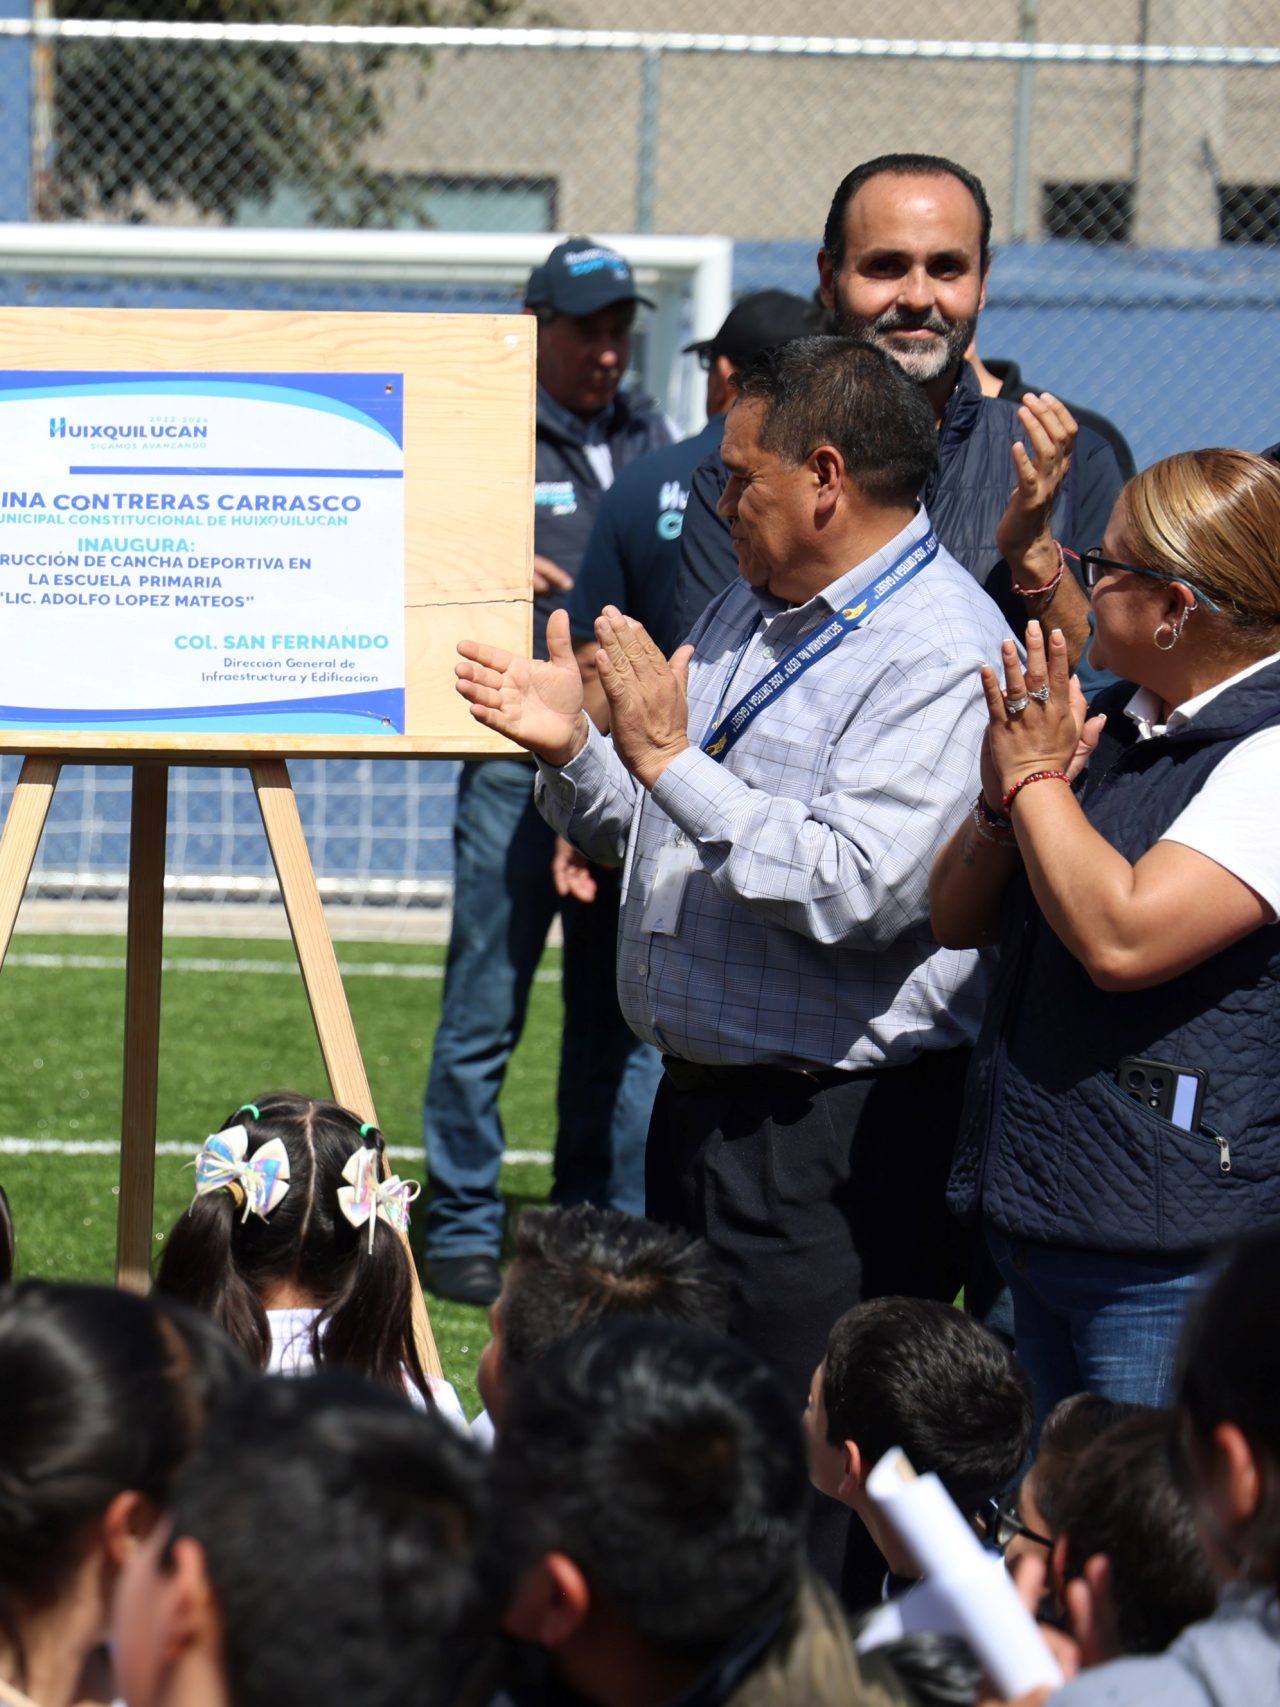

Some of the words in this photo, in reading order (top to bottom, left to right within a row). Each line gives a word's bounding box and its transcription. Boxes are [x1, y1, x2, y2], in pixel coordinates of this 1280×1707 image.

[49, 417, 208, 440] HUIXQUILUCAN
[90, 442, 138, 450] SIGAMOS
[142, 441, 208, 449] AVANZANDO
[53, 493, 211, 511] CONTRERAS
[217, 494, 362, 512] CARRASCO
[68, 514, 204, 526] CONSTITUCIONAL
[207, 515, 227, 526] DE
[231, 515, 349, 527] HUIXQUILUCAN
[78, 537, 196, 553] INAUGURA:
[83, 555, 106, 568] DE
[110, 555, 183, 569] CANCHA
[187, 557, 285, 570] DEPORTIVA
[288, 557, 312, 570] EN
[28, 573, 50, 586] LA
[53, 574, 132, 587] ESCUELA
[139, 575, 222, 588] PRIMARIA
[40, 593, 111, 606] ADOLFO
[115, 594, 171, 607] LOPEZ
[174, 634, 218, 650] COL.
[223, 634, 266, 650] SAN
[272, 634, 390, 649] FERNANDO
[805, 621, 844, 654] SECUNDARIA
[223, 657, 282, 669] Dirección
[285, 658, 337, 669] General
[340, 659, 356, 669] de
[784, 657, 802, 675] 0379
[201, 671, 297, 682] Infraestructura
[300, 673, 308, 685] y
[748, 683, 773, 707] ORTEGA
